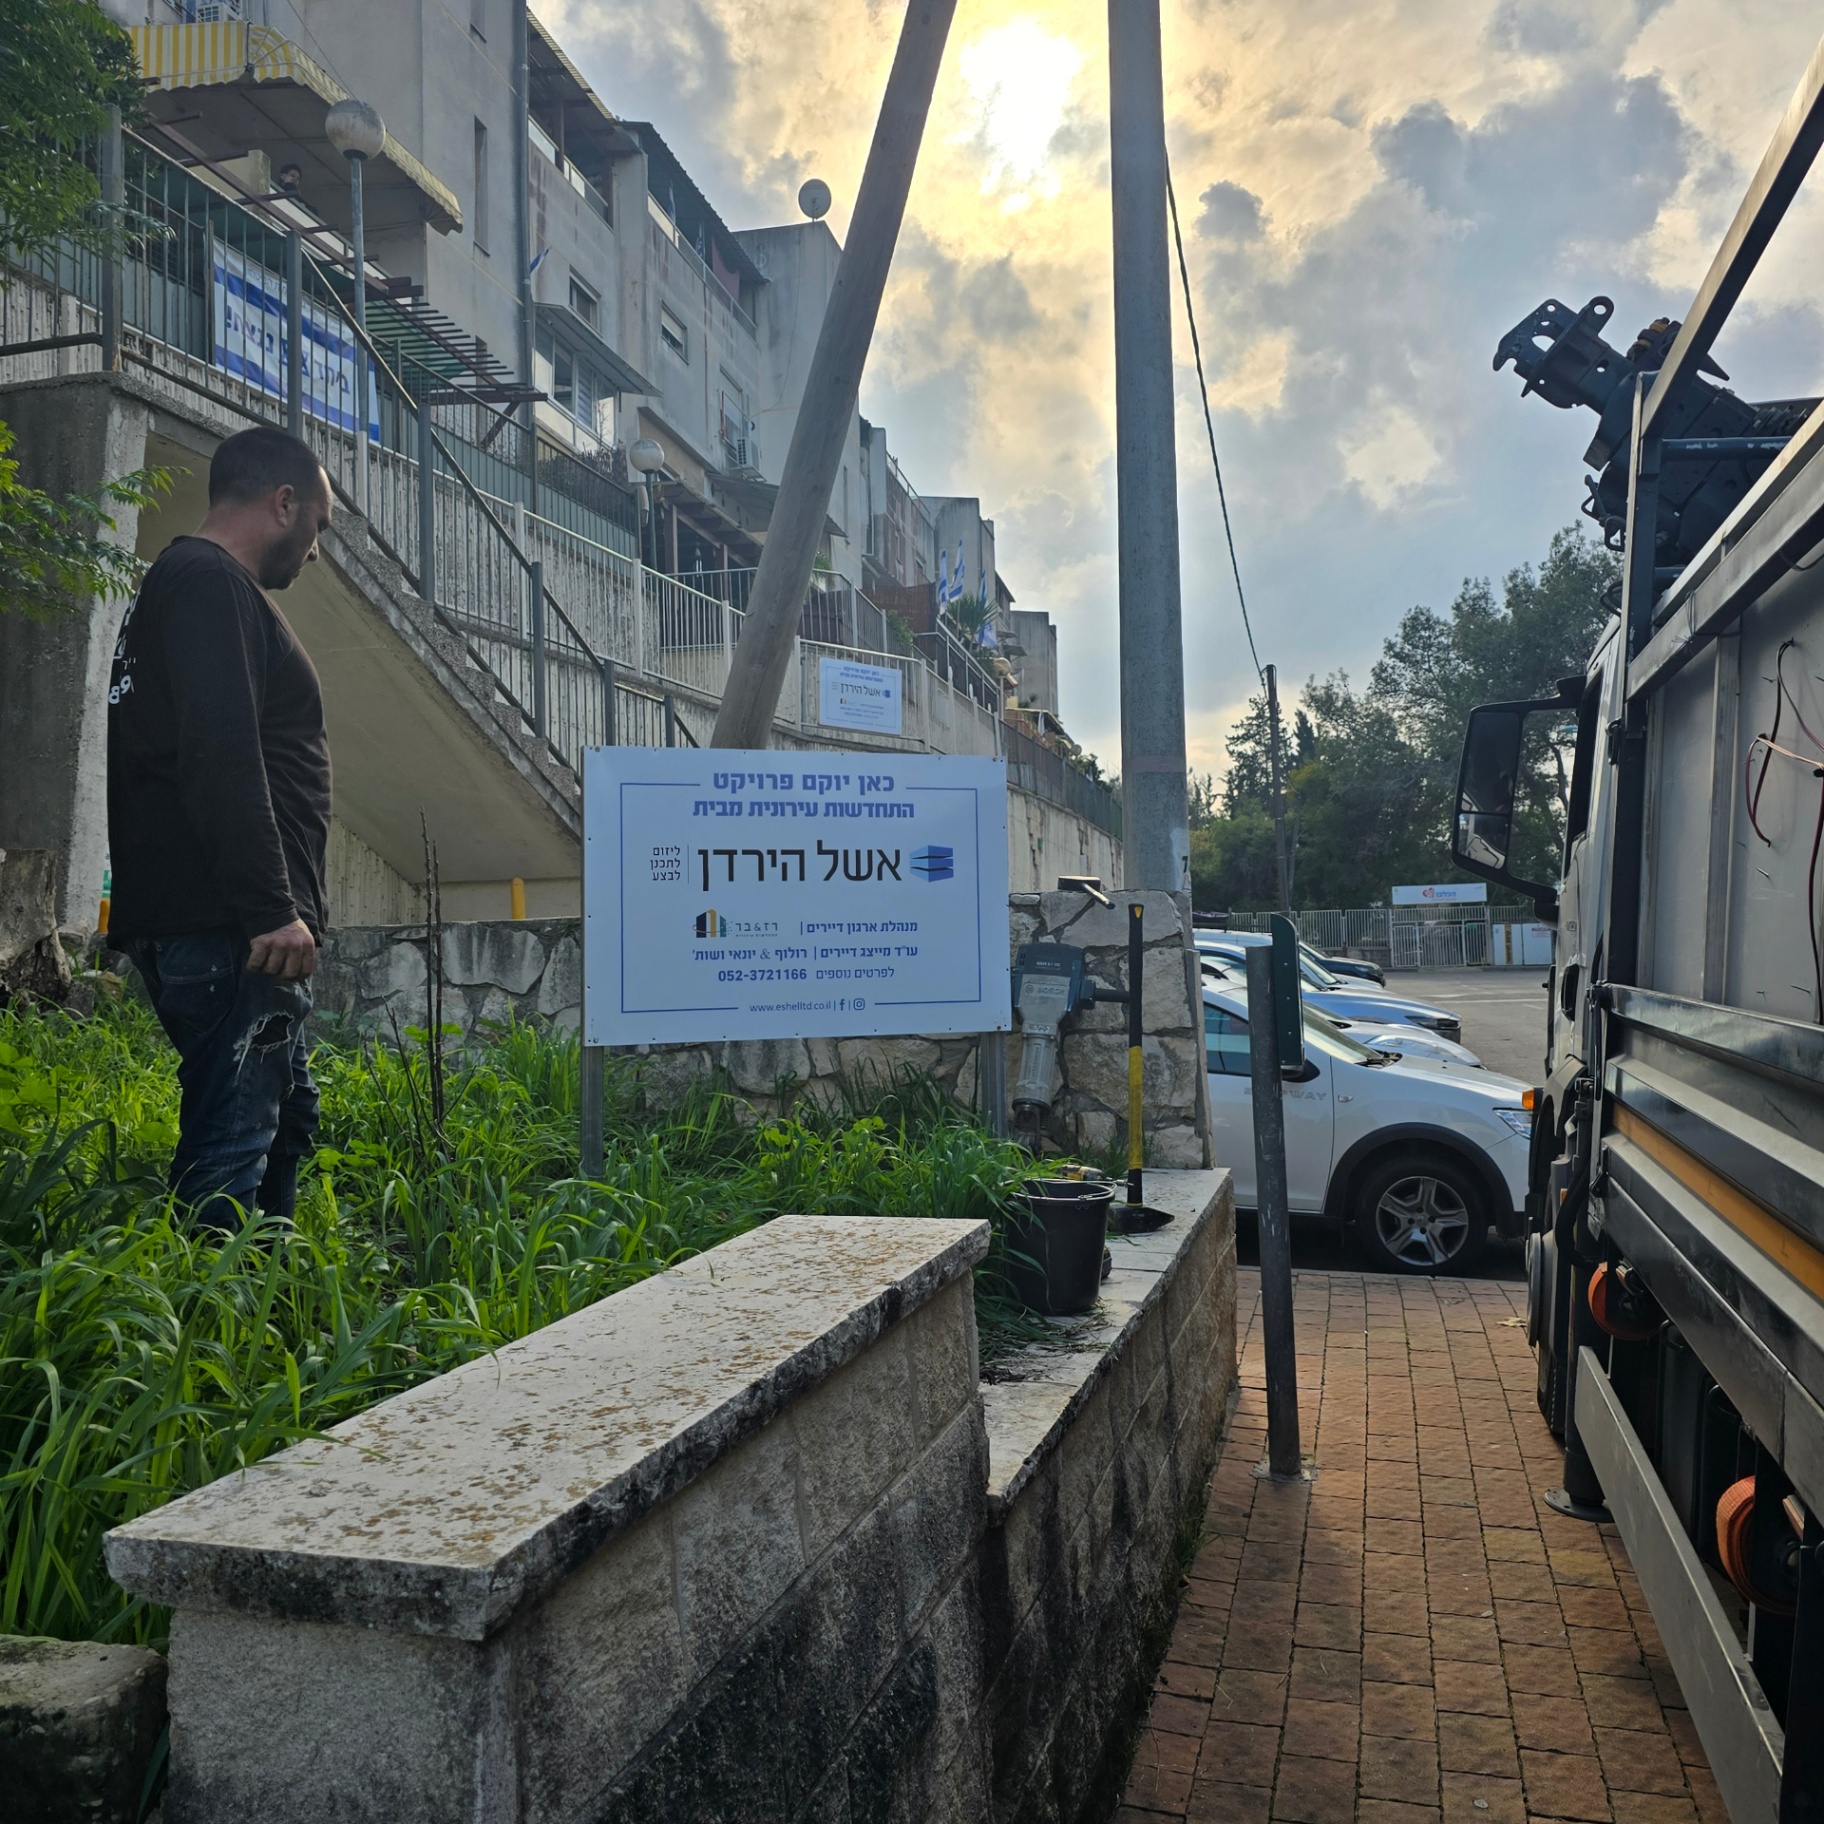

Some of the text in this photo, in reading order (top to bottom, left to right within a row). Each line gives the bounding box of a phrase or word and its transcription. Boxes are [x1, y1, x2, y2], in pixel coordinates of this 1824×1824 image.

[840, 683, 862, 695] הירדן
[863, 685, 881, 697] אשל
[714, 773, 894, 795] כאן יוקם פרויקט
[693, 801, 914, 818] התחדשות עירונית מבית
[653, 846, 680, 855] ליזום
[650, 858, 680, 870] לתכנן
[698, 840, 901, 891] אשל הירדן
[652, 870, 680, 881] לבצע
[807, 920, 918, 935] מנהלת ארגון דיירים
[728, 949, 756, 960] יונאי
[759, 949, 771, 960] &
[775, 947, 807, 961] רולוף
[820, 947, 858, 959] דיירים
[860, 946, 891, 958] מייצג
[718, 966, 894, 981] לפרטים נוספים 052-3721166
[749, 1000, 832, 1013] www.eshelltd.co.il
